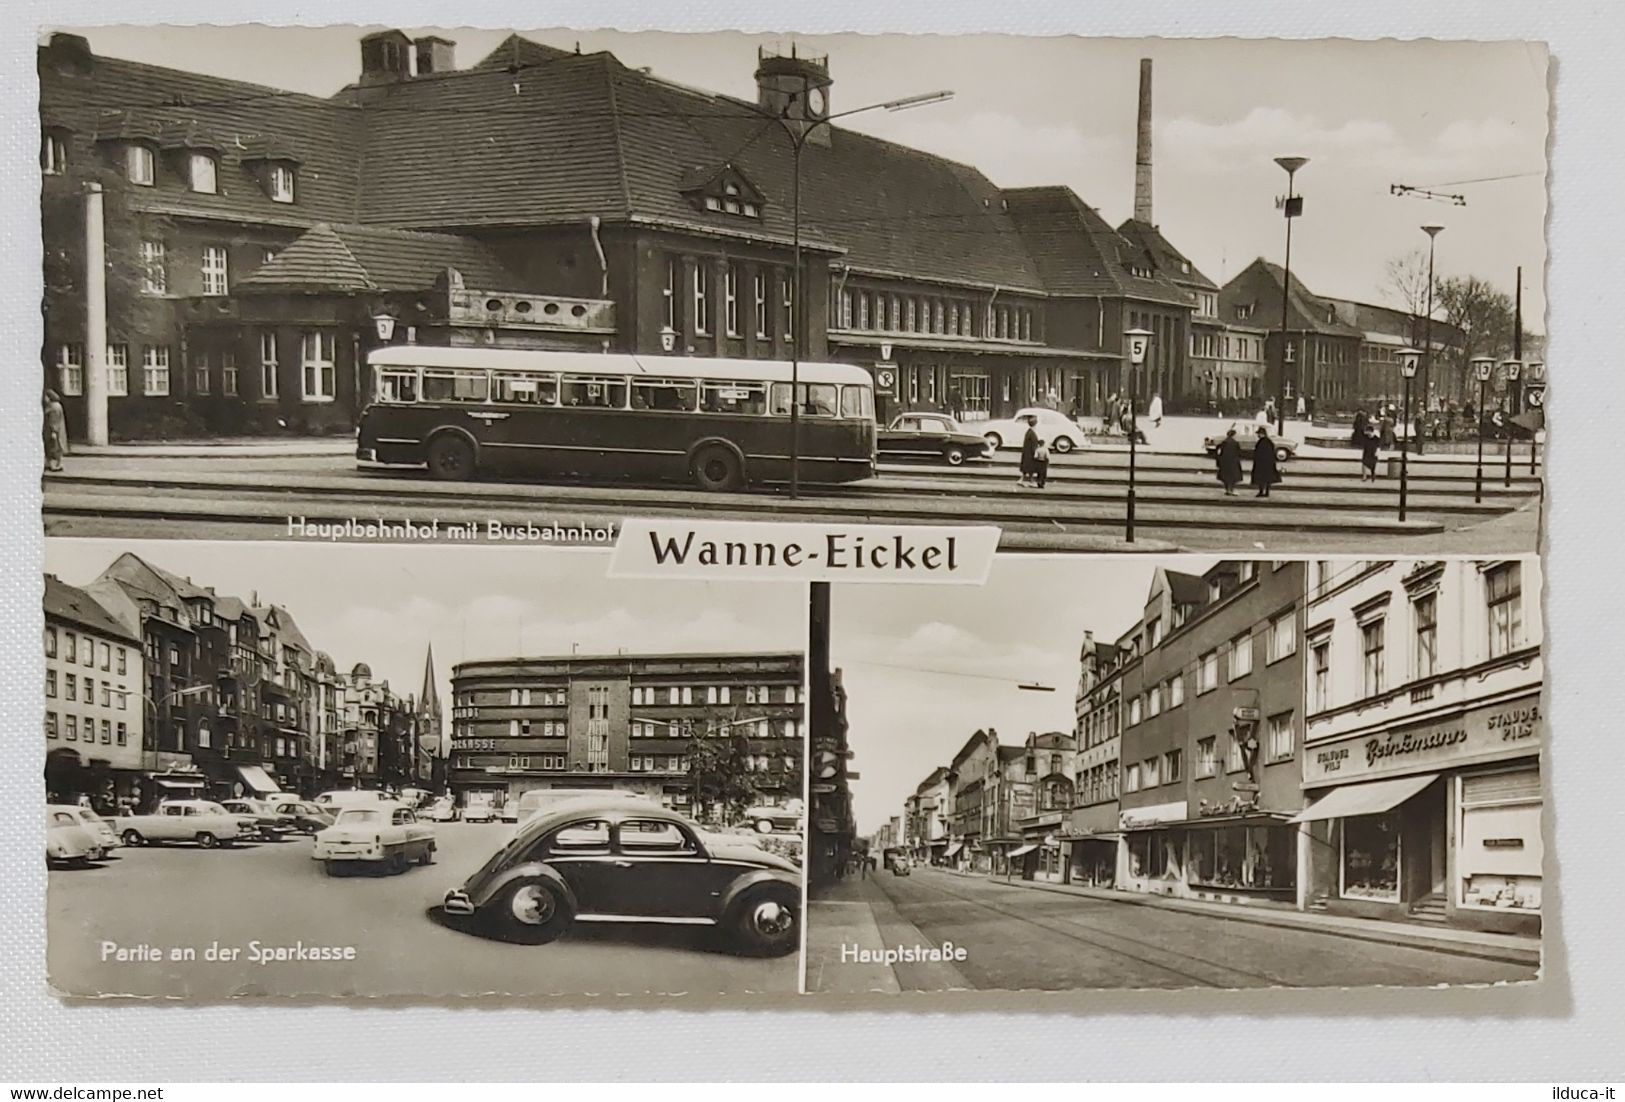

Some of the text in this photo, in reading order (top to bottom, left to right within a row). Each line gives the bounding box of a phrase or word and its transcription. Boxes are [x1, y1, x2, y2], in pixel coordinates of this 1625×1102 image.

[1133, 341, 1143, 355] 5
[1406, 359, 1415, 370] 4
[1482, 365, 1490, 376] 3
[288, 516, 615, 543] Hauptbahnhof mit Busbahnhof
[649, 531, 958, 571] Wanne-Eickel
[1488, 706, 1543, 730] STAUDE
[1502, 723, 1533, 742] PILS
[101, 940, 357, 966] Partie an der Sparkasse
[841, 941, 968, 967] Hauptstraße
